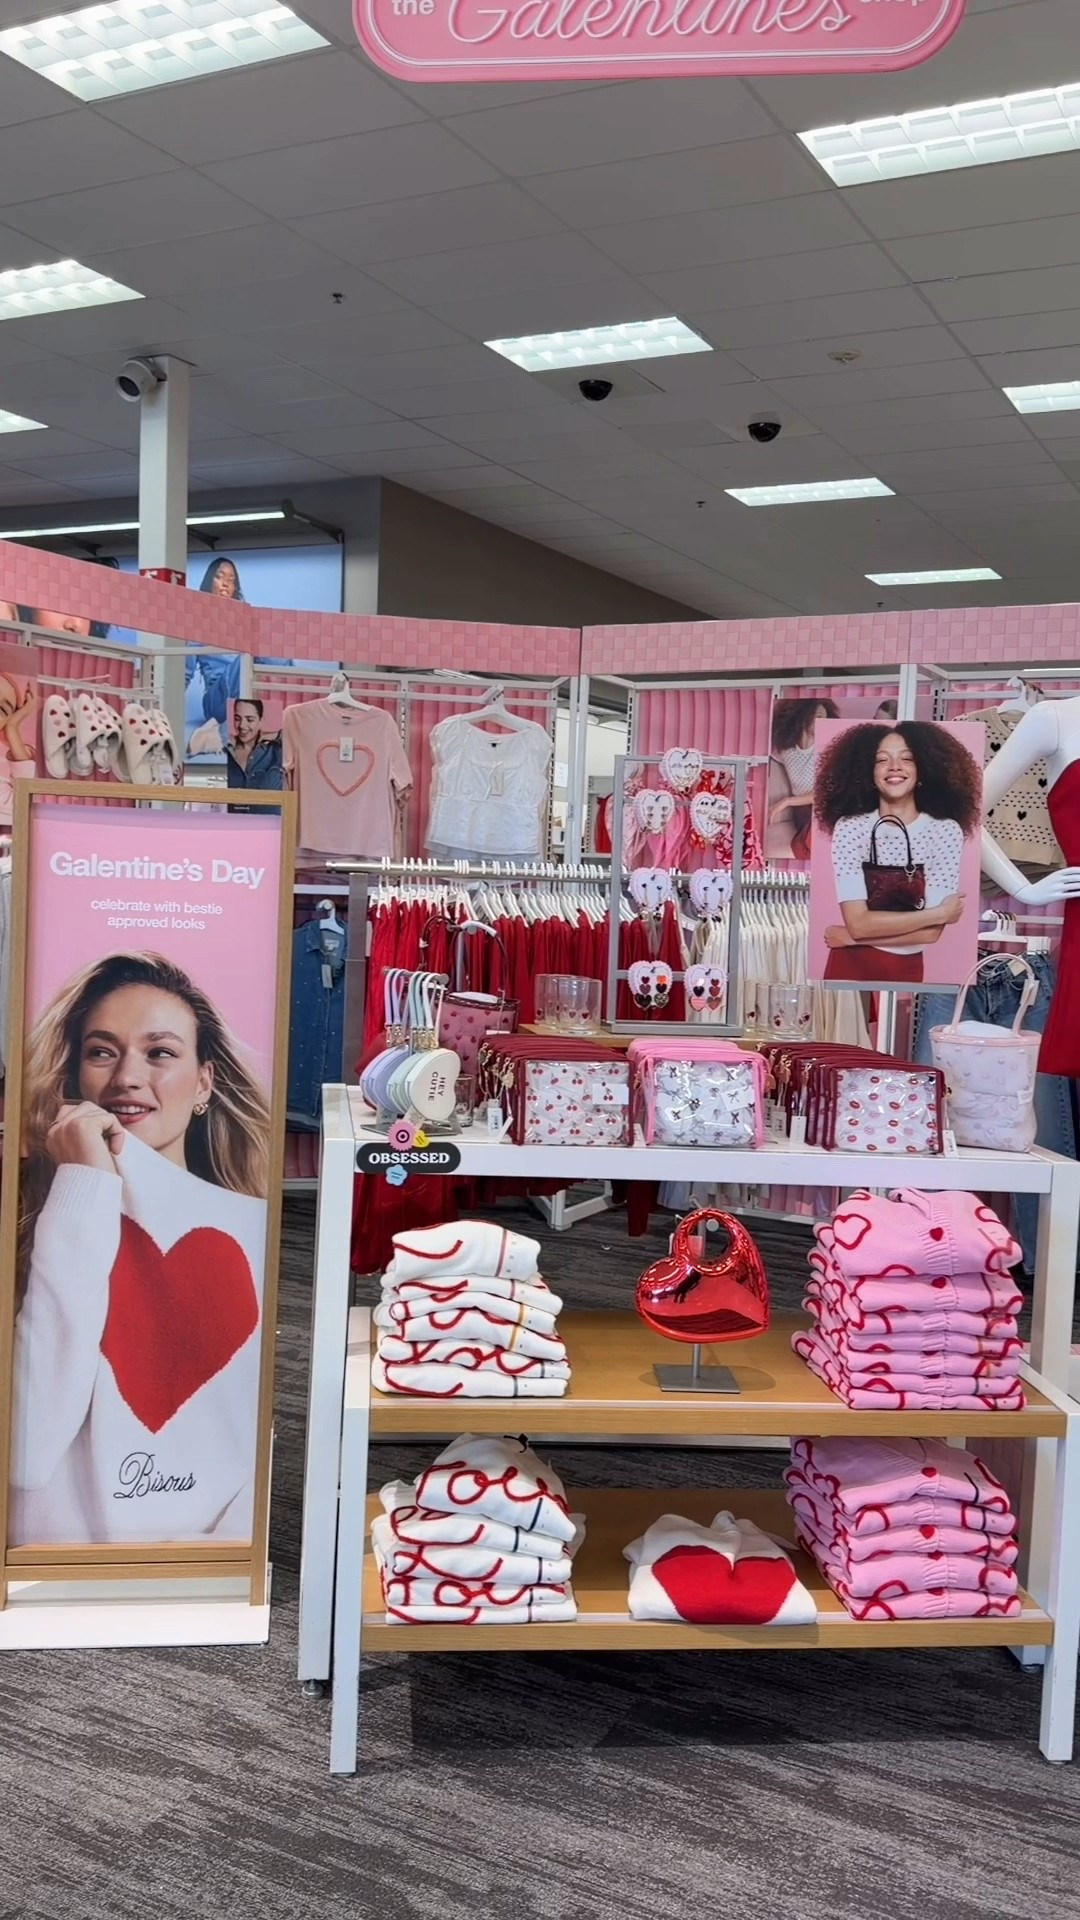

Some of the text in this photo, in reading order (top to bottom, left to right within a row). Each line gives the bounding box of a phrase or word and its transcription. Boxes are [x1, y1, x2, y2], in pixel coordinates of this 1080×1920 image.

[391, 0, 435, 15] the
[49, 851, 265, 890] Galentine’s Day
[91, 899, 223, 915] celebrate with bestie
[107, 915, 206, 930] approved looks
[428, 1071, 439, 1101] CUTIE
[437, 1076, 446, 1096] HEY
[368, 1152, 450, 1164] OBSESSED
[113, 1451, 197, 1499] Bisous
